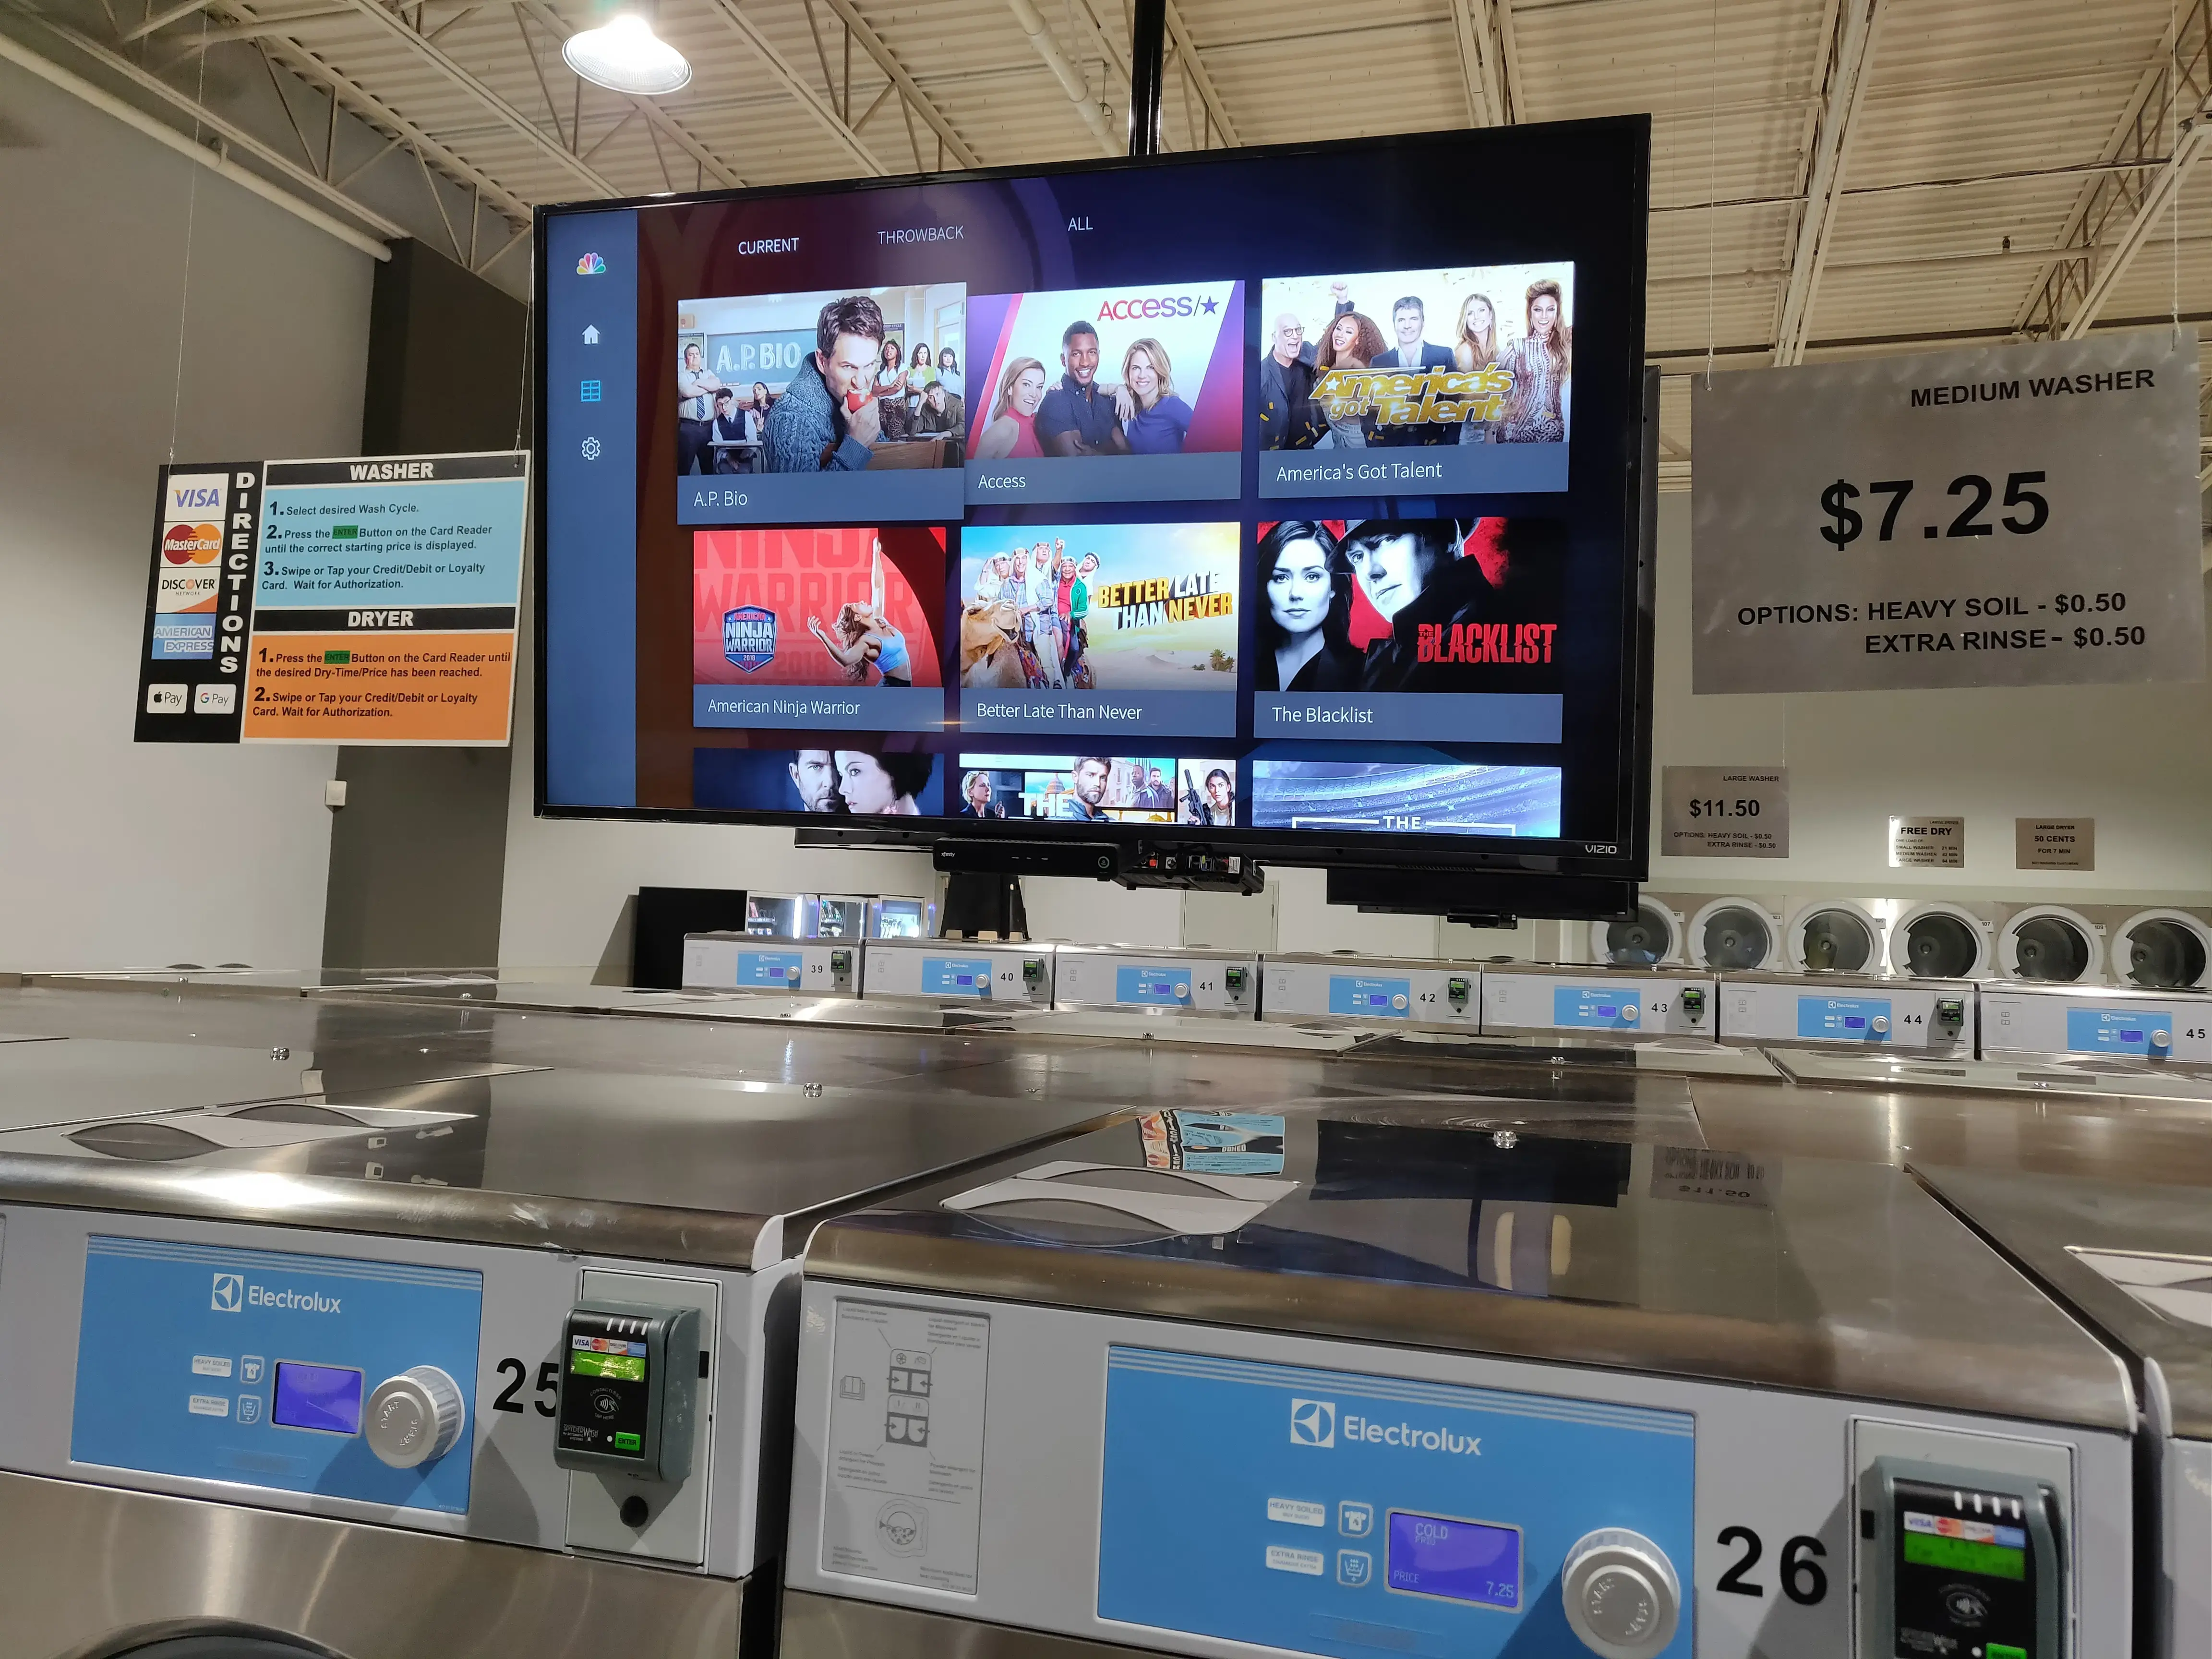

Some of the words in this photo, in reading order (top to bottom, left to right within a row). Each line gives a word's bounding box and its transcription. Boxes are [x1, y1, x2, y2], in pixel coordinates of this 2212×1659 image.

[1068, 216, 1094, 232] ALL
[877, 225, 965, 246] THROWBACK
[738, 237, 799, 255] CURRENT
[716, 345, 756, 373] A.P.
[759, 342, 802, 371] BIO
[1309, 362, 1515, 399] America's
[1910, 381, 2020, 408] MEDIUM
[2028, 369, 2155, 397] WASHER
[1329, 397, 1371, 421] got
[1371, 394, 1508, 425] Talent
[350, 462, 434, 481] WASHER
[1276, 463, 1354, 482] America's
[1358, 463, 1387, 481] Got
[1390, 461, 1443, 480] Talent
[978, 474, 1026, 490] Access
[173, 489, 220, 507] VISA
[693, 491, 720, 506] A.P.
[723, 490, 748, 506] Bio
[270, 501, 284, 516] 1.
[287, 505, 316, 516] Select
[323, 505, 356, 515] desired
[359, 504, 385, 514] Wash
[389, 503, 419, 515] Cycle.
[1820, 470, 2049, 552] $7.25
[266, 524, 282, 539] 2.
[285, 529, 312, 539] Press
[315, 529, 330, 539] the
[334, 528, 358, 536] ENTER
[360, 528, 392, 538] Button
[396, 529, 408, 537] on
[411, 527, 427, 536] the
[430, 526, 454, 536] Card
[457, 525, 493, 535] Reader
[164, 538, 221, 552] MasterCard
[265, 543, 286, 553] until
[289, 543, 304, 553] the
[308, 543, 342, 553] correct
[345, 542, 383, 553] starting
[386, 541, 411, 553] price
[414, 541, 422, 551] is
[425, 540, 477, 552] displayed.
[220, 472, 255, 673] DIRECTIONS
[264, 561, 279, 576] 3.
[281, 565, 311, 577] Swipe
[327, 565, 344, 577] Tap
[347, 566, 370, 577] your
[373, 564, 432, 575] Credit/Debit
[435, 565, 445, 573] or
[448, 563, 485, 575] Loyalty
[162, 578, 215, 590] DISCOVER
[262, 580, 288, 590] Card.
[294, 579, 314, 589] Wait
[317, 579, 331, 589] for
[333, 579, 404, 589] Authorization.
[1098, 577, 1169, 609] BETTER
[1173, 570, 1220, 598] LATE
[1113, 601, 1166, 631] THAN
[1168, 592, 1233, 623] NEVER
[1738, 602, 1858, 625] OPTIONS:
[1867, 599, 1957, 621] HEAVY
[1964, 596, 2029, 618] SOIL
[2054, 591, 2126, 616] $0.50
[348, 611, 414, 627] DRYER
[733, 612, 766, 621] AMERICAN
[154, 627, 211, 637] AMERICAN
[726, 621, 773, 638] NINJA
[166, 641, 214, 650] EXPRESS
[726, 638, 773, 652] WARRIOR
[1417, 623, 1557, 663] BLACKLIST
[1864, 632, 1955, 653] EXTRA
[2073, 625, 2146, 648] $0.50
[259, 648, 274, 662] 1.
[276, 653, 304, 662] Press
[307, 653, 322, 662] the
[351, 653, 385, 662] Button
[404, 653, 419, 662] the
[422, 652, 446, 662] Card
[449, 652, 486, 662] Reader
[488, 652, 511, 662] until
[256, 668, 271, 677] the
[274, 668, 311, 677] desired
[314, 667, 387, 679] Dry-Time/Price
[390, 667, 409, 677] has
[411, 667, 436, 677] been
[439, 667, 482, 677] reached.
[164, 691, 182, 707] Pay
[212, 693, 229, 707] Pay
[708, 699, 769, 714] American
[773, 698, 807, 717] Ninja
[810, 699, 861, 716] Warrior
[977, 703, 1021, 719] Better
[1024, 703, 1055, 719] Late
[1056, 703, 1094, 720] Than
[1098, 705, 1142, 721] Never
[1272, 706, 1302, 723] The
[1306, 707, 1374, 724] Blacklist
[1018, 792, 1073, 817] THE
[1689, 798, 1760, 818] $11.50
[1382, 816, 1422, 830] THE
[1585, 844, 1618, 854] VIZIO
[811, 965, 823, 974] 39
[1000, 973, 1013, 981] 40
[1200, 982, 1213, 991] 41
[1419, 993, 1435, 1002] 42
[1651, 1003, 1667, 1013] 43
[1904, 1014, 1922, 1024] 44
[2186, 1028, 2206, 1039] 45
[248, 1285, 342, 1314] Electrolux
[575, 1339, 589, 1347] VISA
[1344, 1415, 1482, 1456] Electrolux
[1270, 1501, 1295, 1510] HEAVY
[1297, 1505, 1323, 1515] SOILED
[1415, 1523, 1448, 1539] COLD
[1271, 1550, 1295, 1559] EXTRA
[1297, 1553, 1320, 1562] RINSE
[1716, 1525, 1829, 1606] 26
[1394, 1569, 1419, 1583] PRICE
[1486, 1580, 1514, 1598] 7.25
